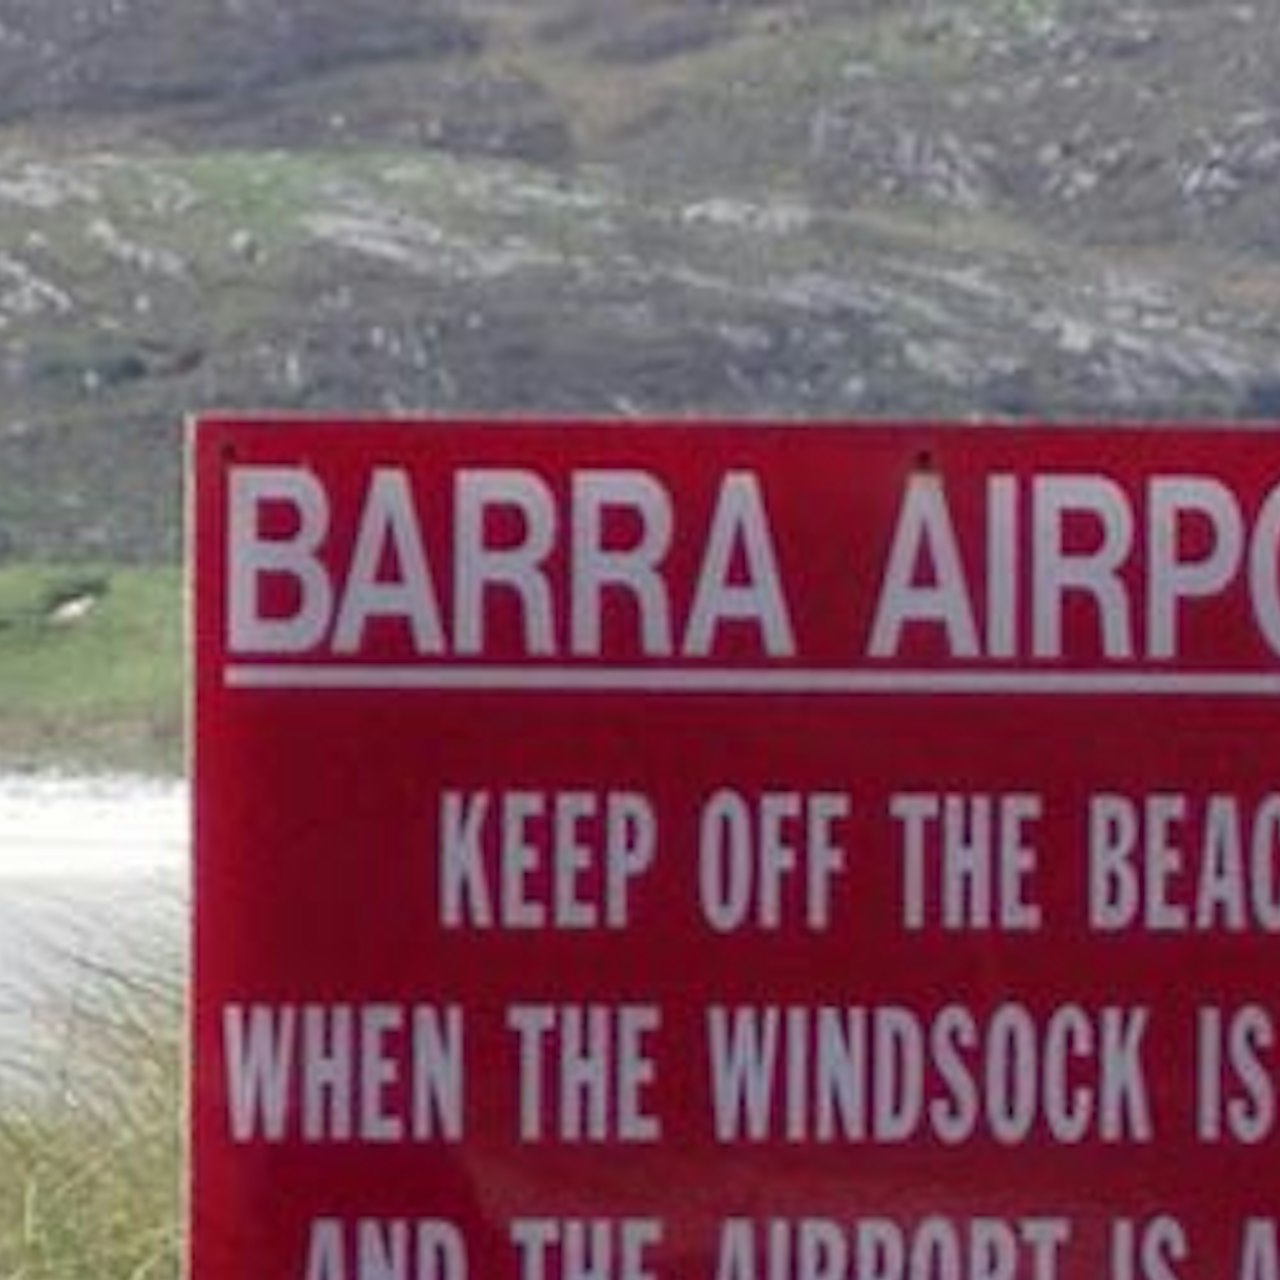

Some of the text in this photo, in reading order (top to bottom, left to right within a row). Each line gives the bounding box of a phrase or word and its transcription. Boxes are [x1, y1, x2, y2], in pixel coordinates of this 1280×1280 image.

[228, 467, 793, 655] BARRA
[443, 793, 653, 928] KEEP
[702, 793, 846, 928] OFF
[892, 795, 1038, 927] THE
[225, 1006, 461, 1139] WHEN
[511, 1008, 657, 1138] THE
[711, 1008, 1147, 1140] WINDSOCK
[1202, 1009, 1270, 1141] IS
